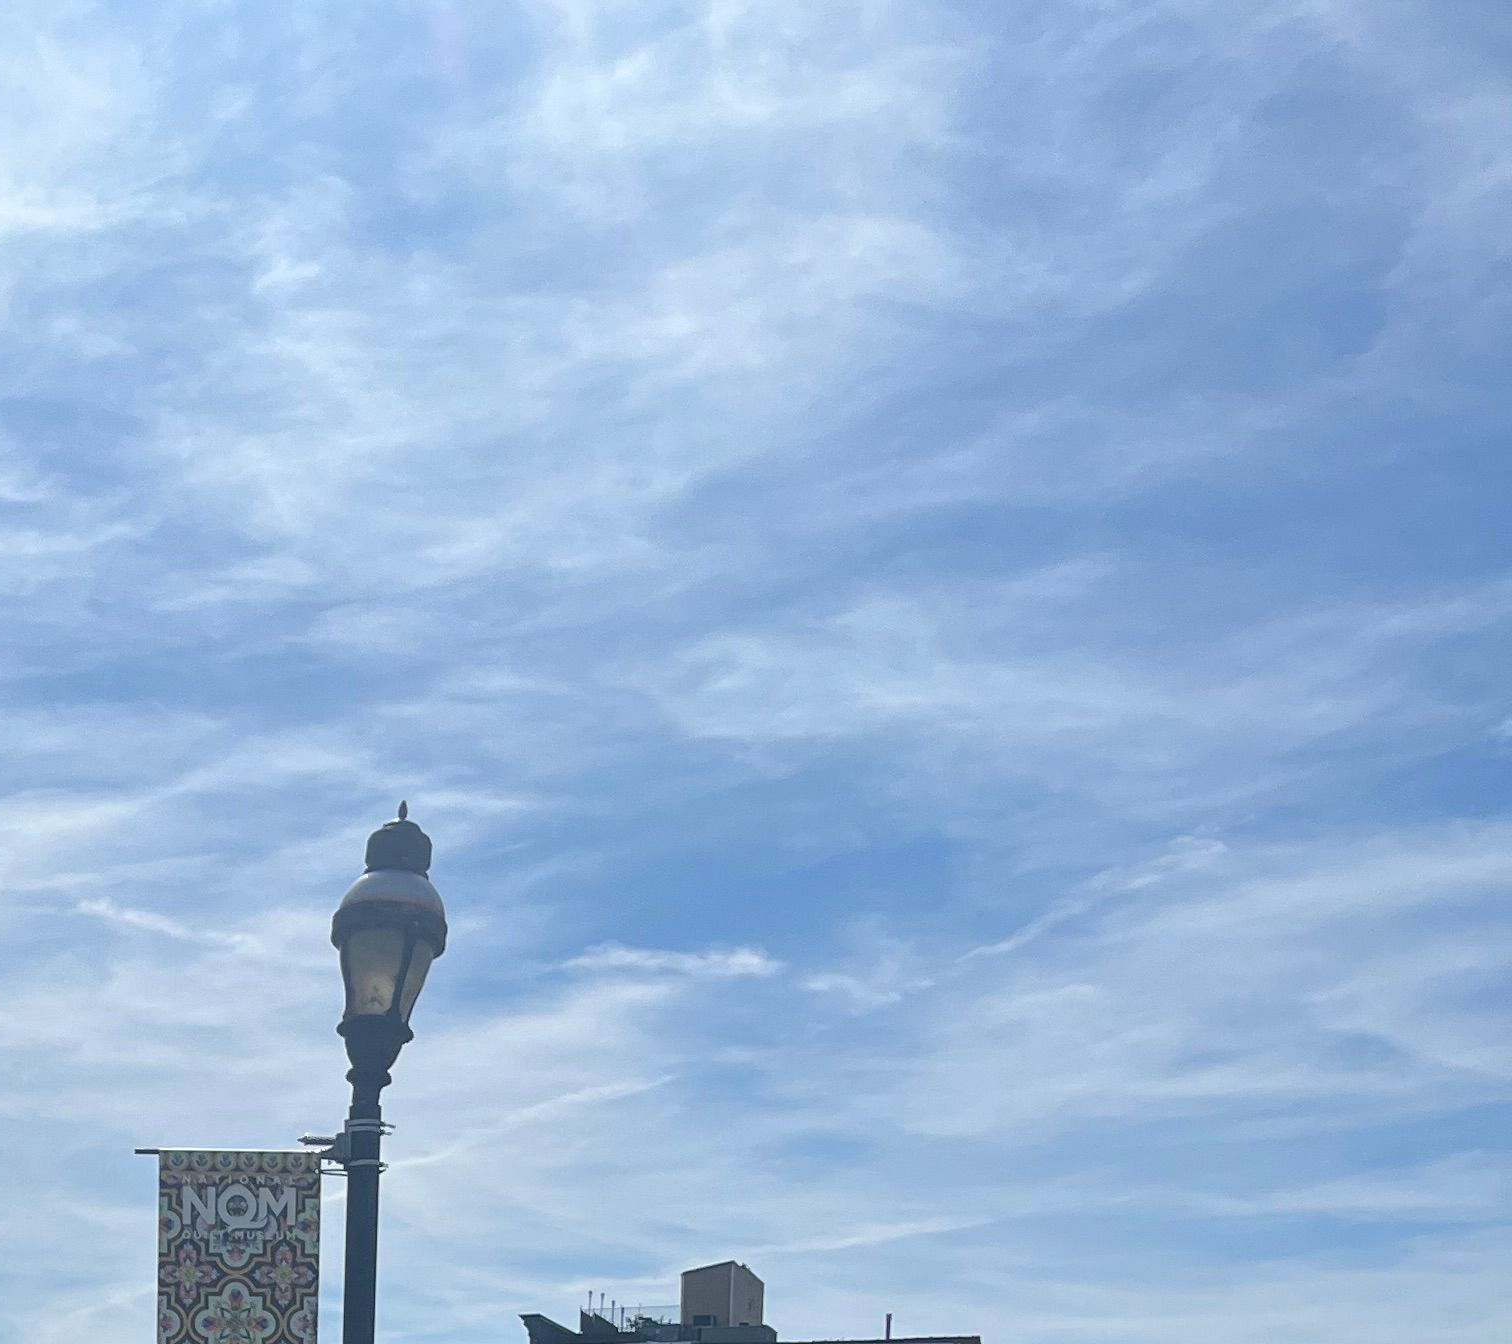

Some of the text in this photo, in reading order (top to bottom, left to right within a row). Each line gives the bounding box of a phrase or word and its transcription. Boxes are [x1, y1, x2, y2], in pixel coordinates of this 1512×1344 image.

[182, 1175, 295, 1184] NATIONAL
[182, 1183, 297, 1232] NQM
[234, 1229, 297, 1241] MUSEUM
